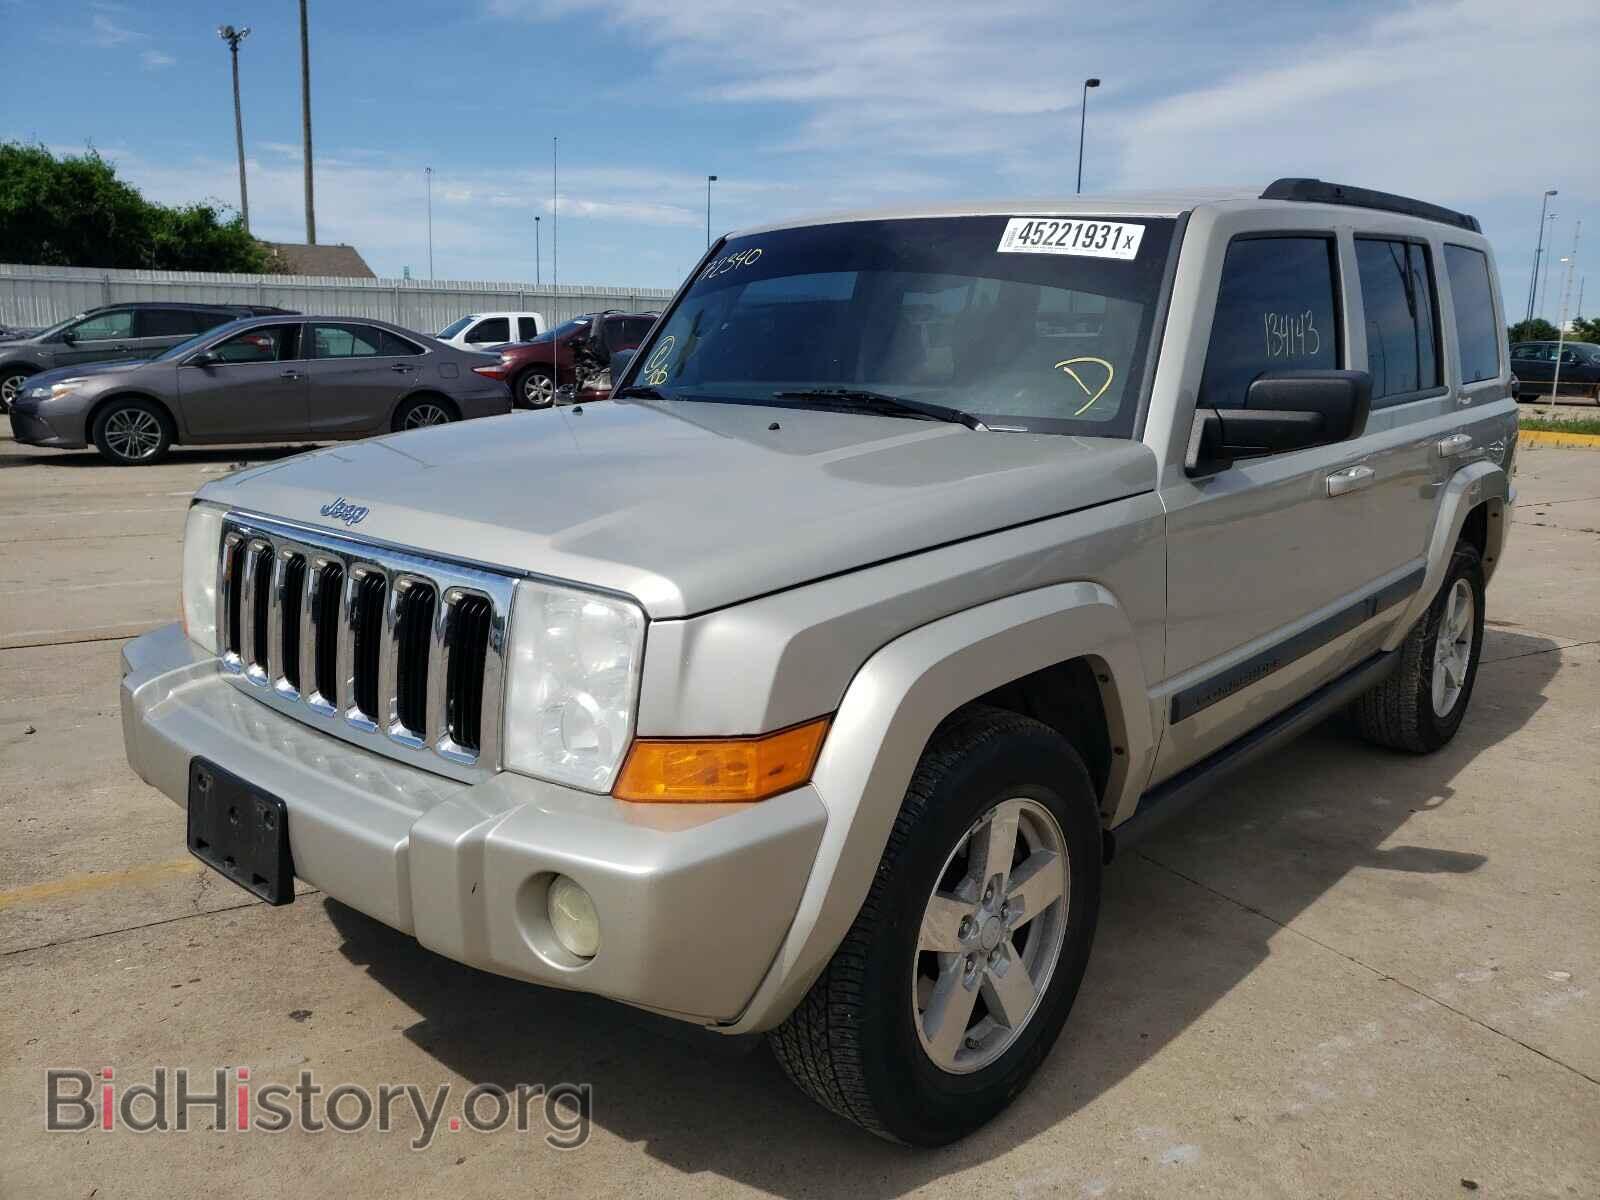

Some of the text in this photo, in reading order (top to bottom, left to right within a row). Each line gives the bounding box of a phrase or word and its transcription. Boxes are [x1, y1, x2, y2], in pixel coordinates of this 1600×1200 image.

[1018, 221, 1123, 250] 45221931
[1264, 309, 1320, 358] 134143
[319, 496, 369, 526] Jeep
